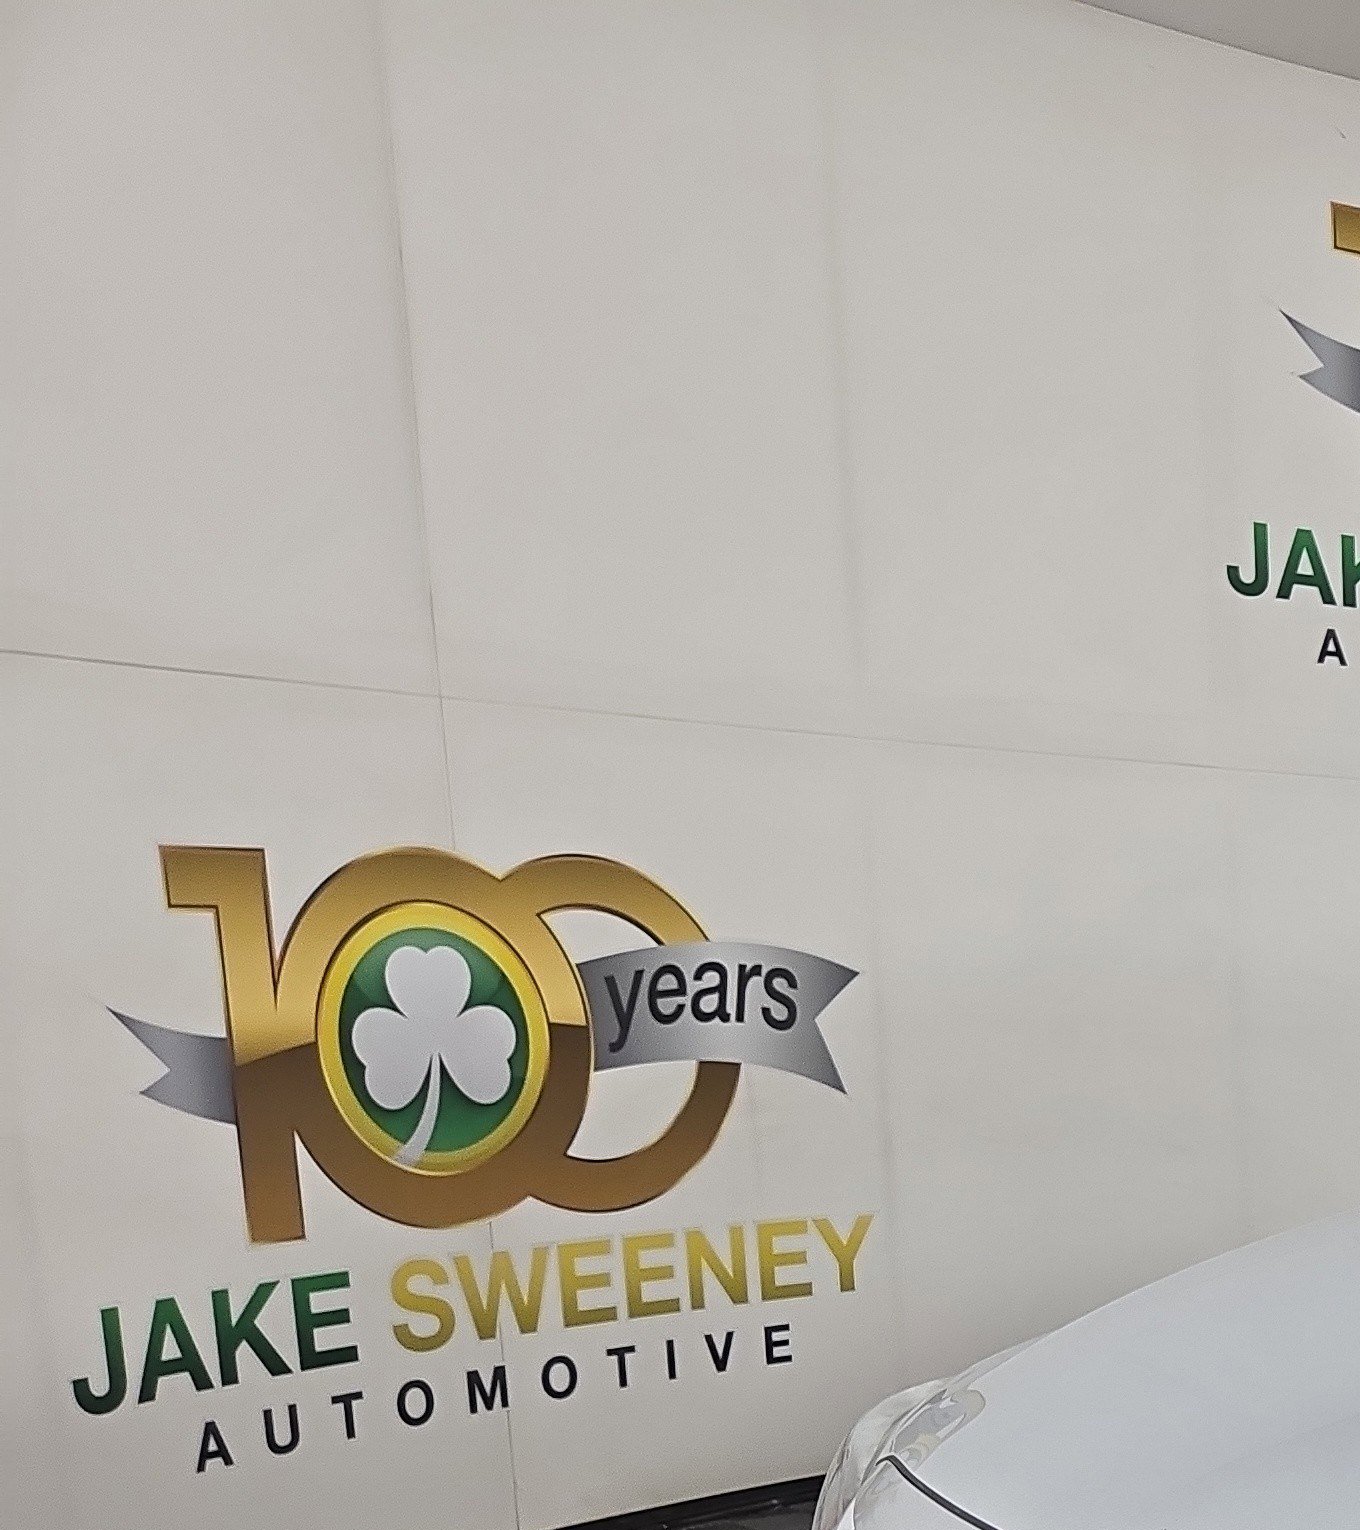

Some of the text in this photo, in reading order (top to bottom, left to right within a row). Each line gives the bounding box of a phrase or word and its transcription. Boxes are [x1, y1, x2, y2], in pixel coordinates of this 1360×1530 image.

[158, 843, 799, 1245] 100 years
[71, 1214, 875, 1416] JAKE SWEENEY
[195, 1323, 795, 1474] AUTOMOTIVE
